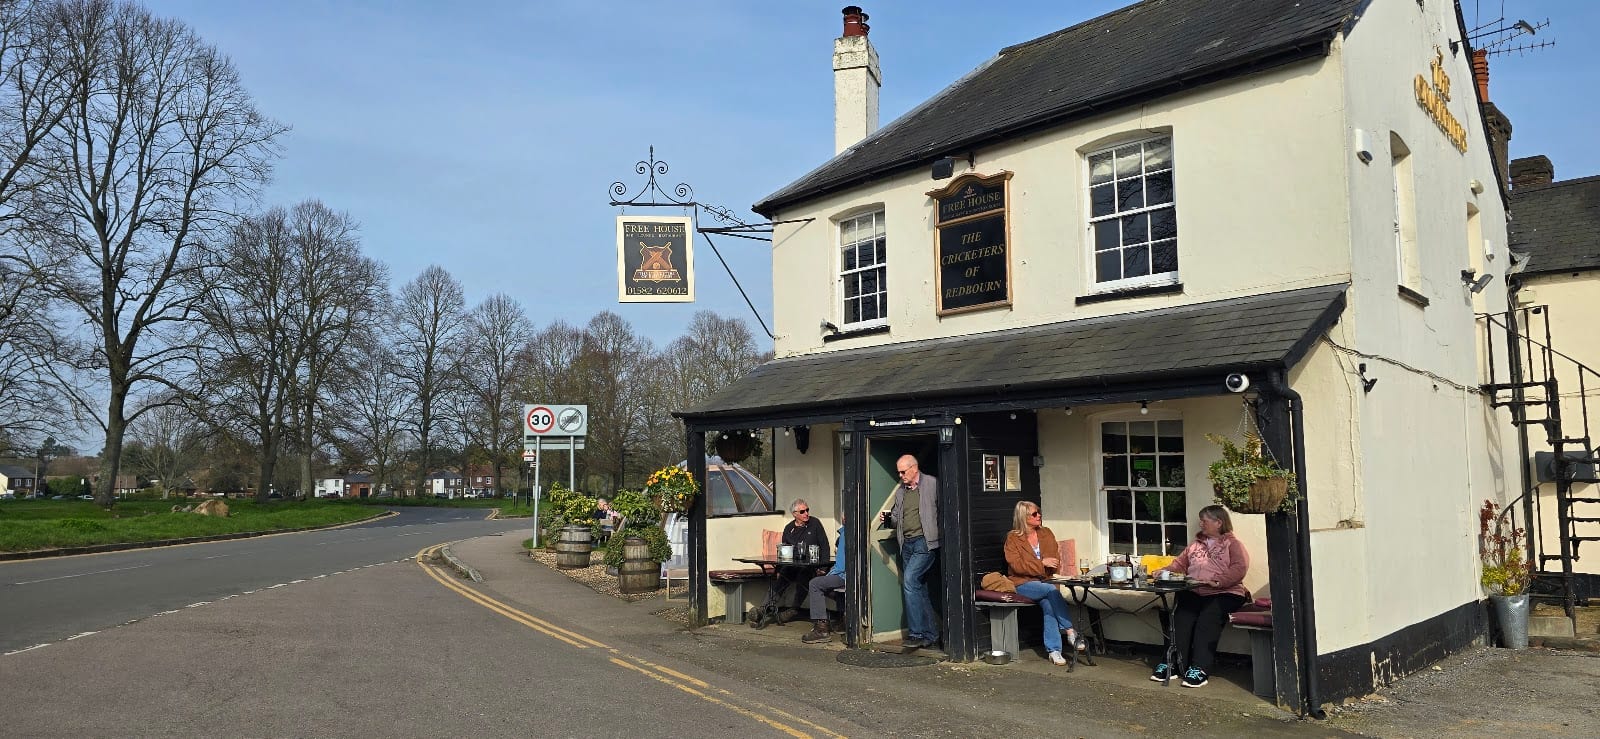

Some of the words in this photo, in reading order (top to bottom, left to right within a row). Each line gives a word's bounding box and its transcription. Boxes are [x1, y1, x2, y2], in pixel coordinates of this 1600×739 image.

[942, 199, 967, 214] FREE
[968, 191, 1001, 207] HOUSE
[625, 224, 650, 233] FREE
[654, 225, 685, 233] HOUSE
[961, 231, 982, 245] THE
[941, 243, 1005, 265] CRICKETERS
[965, 266, 980, 278] OF
[627, 286, 653, 295] 01582
[656, 286, 687, 295] 620612
[945, 279, 1002, 299] REDBOURN
[531, 414, 551, 425] 30
